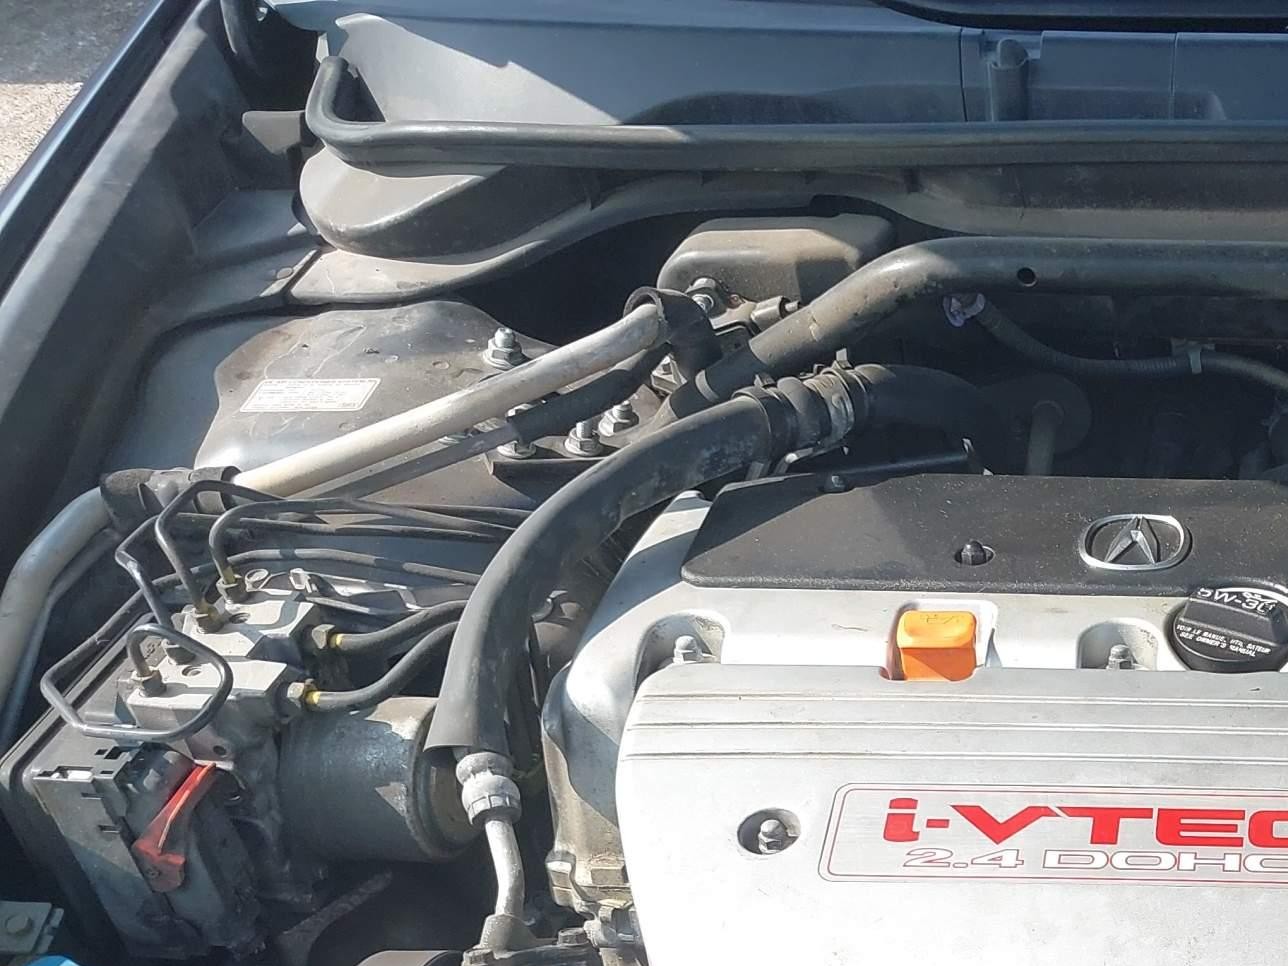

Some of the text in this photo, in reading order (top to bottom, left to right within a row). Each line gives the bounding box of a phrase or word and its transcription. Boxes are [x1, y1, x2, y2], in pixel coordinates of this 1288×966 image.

[1180, 631, 1194, 639] SEE
[1230, 645, 1256, 657] MANUAL
[903, 847, 1025, 869] 2.4
